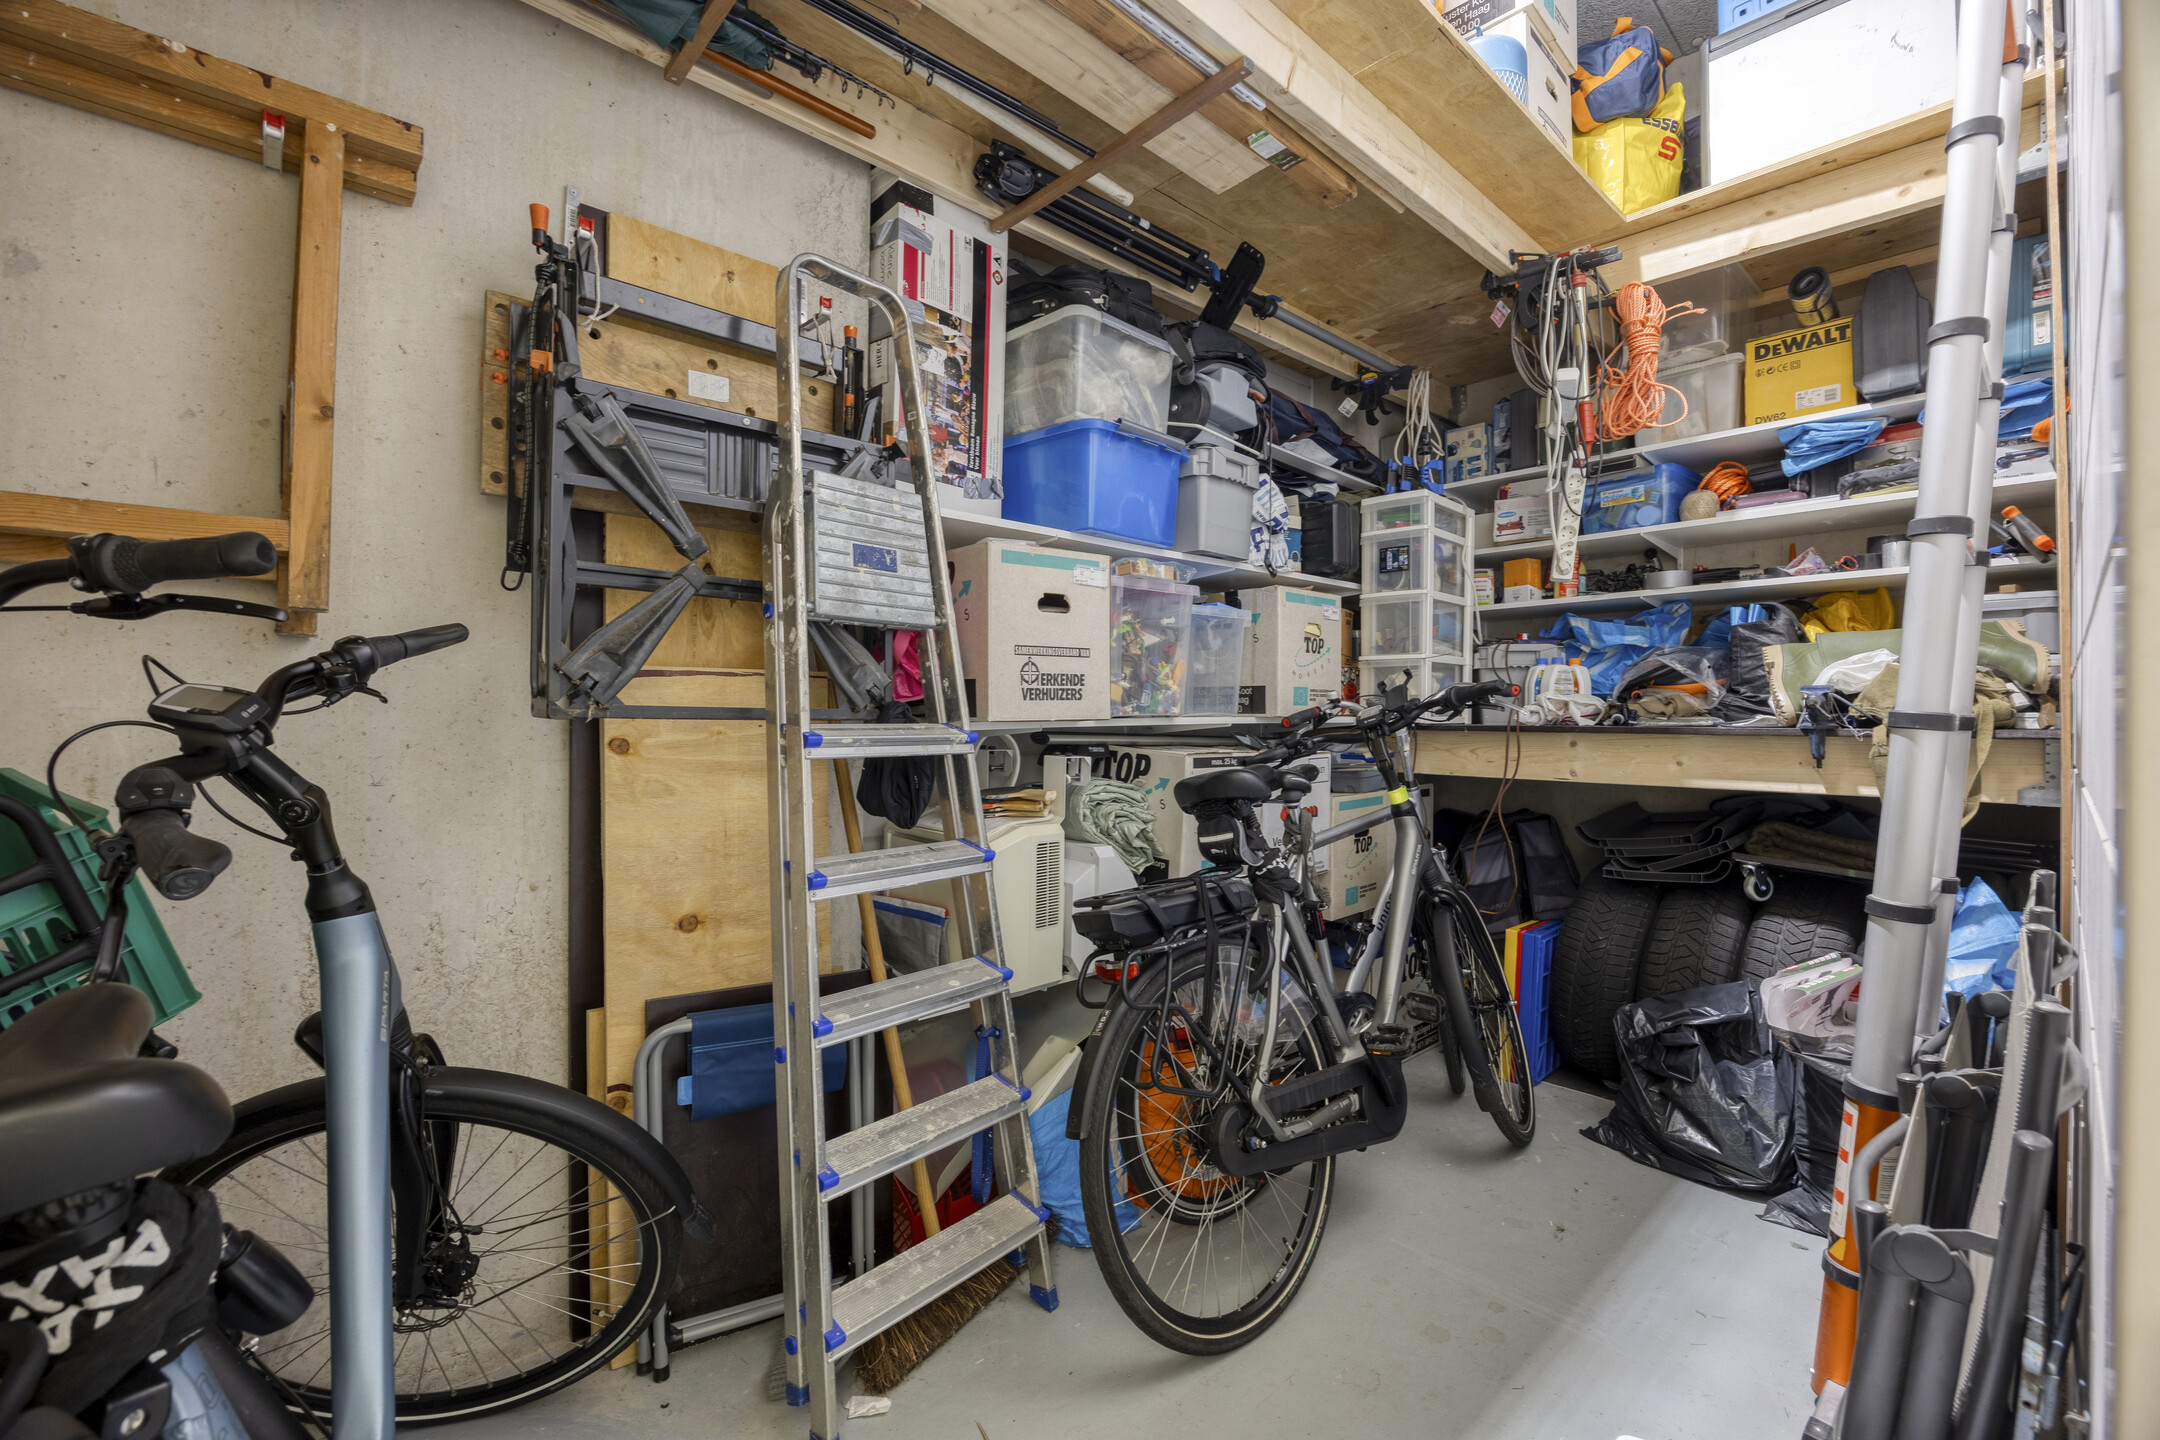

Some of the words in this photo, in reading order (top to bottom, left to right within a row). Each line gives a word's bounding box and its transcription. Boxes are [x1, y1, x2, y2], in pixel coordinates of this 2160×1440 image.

[1464, 3, 1490, 21] Haag
[1014, 646, 1080, 657] SAMENWERKINGSVERBAND
[1303, 636, 1324, 654] TOP
[1021, 687, 1083, 701] VERHUIZERS
[1095, 751, 1152, 784] TOP
[1353, 836, 1373, 854] TOP
[380, 970, 389, 1043] SPARTA
